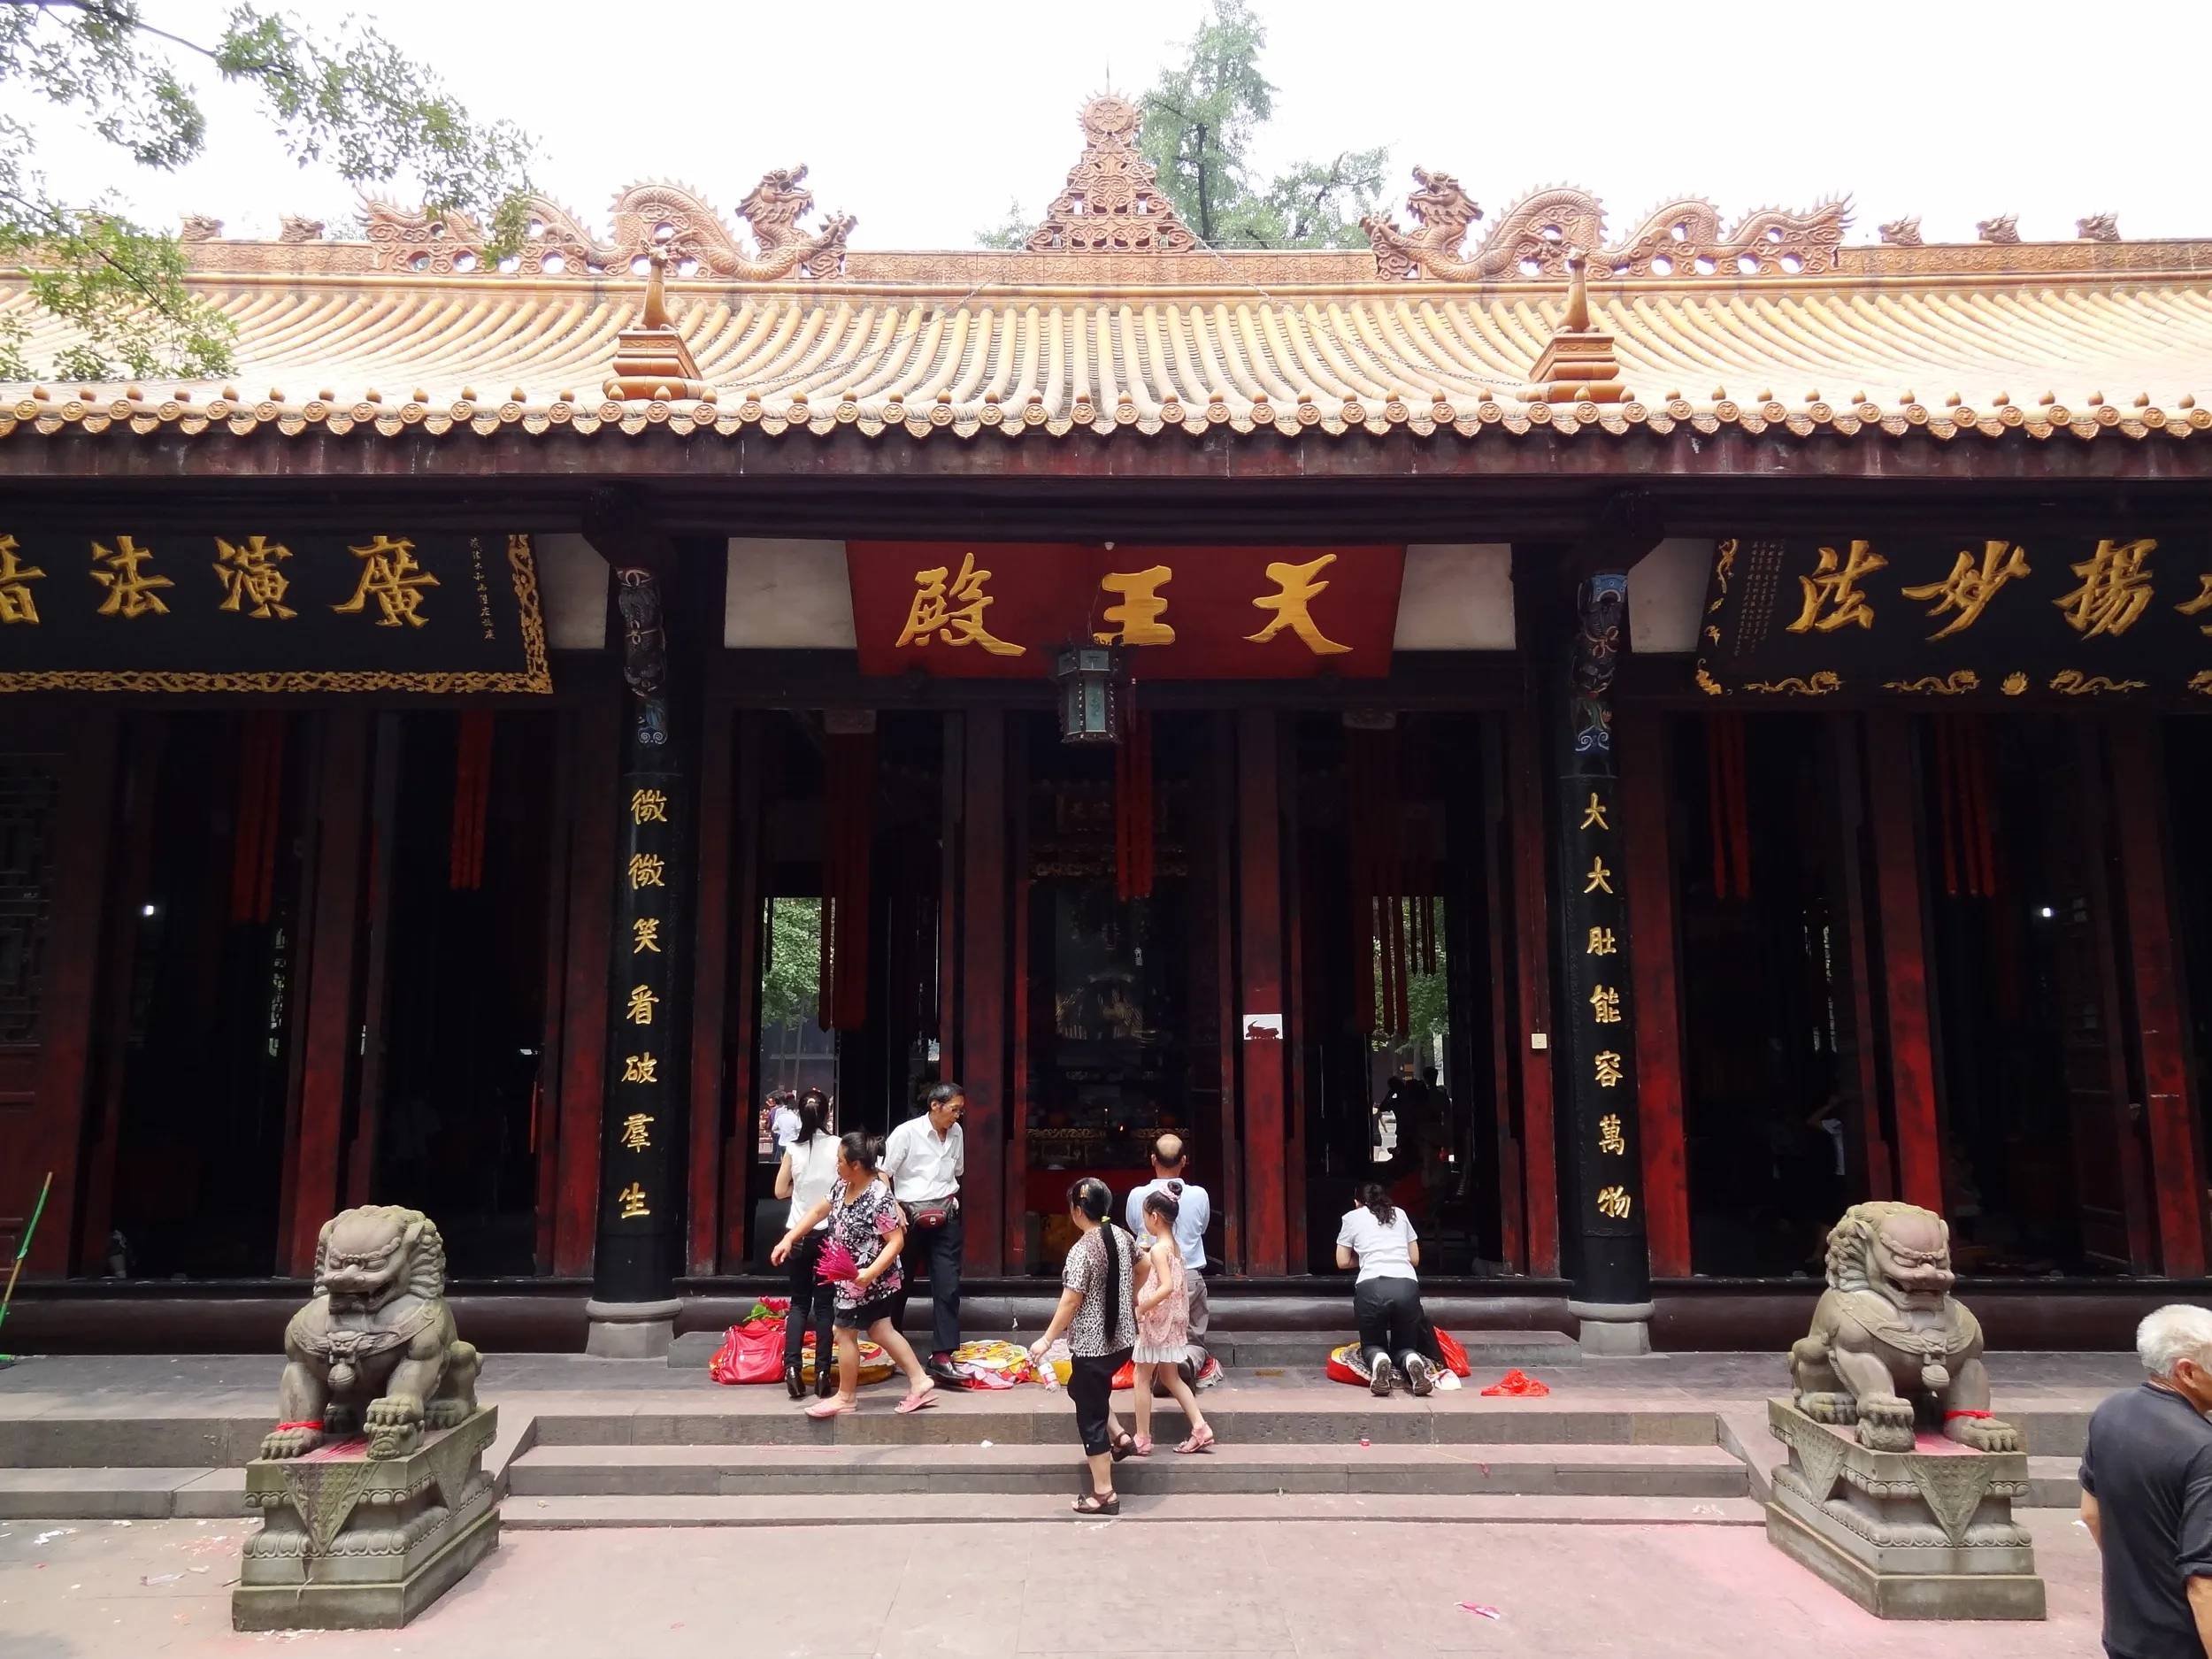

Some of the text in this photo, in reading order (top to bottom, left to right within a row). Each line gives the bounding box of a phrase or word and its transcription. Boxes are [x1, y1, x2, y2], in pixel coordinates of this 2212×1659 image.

[895, 551, 1354, 657] 天王殿
[1786, 538, 2212, 641] 揚妙法
[1580, 791, 1632, 1219] 大大肚能容萬物
